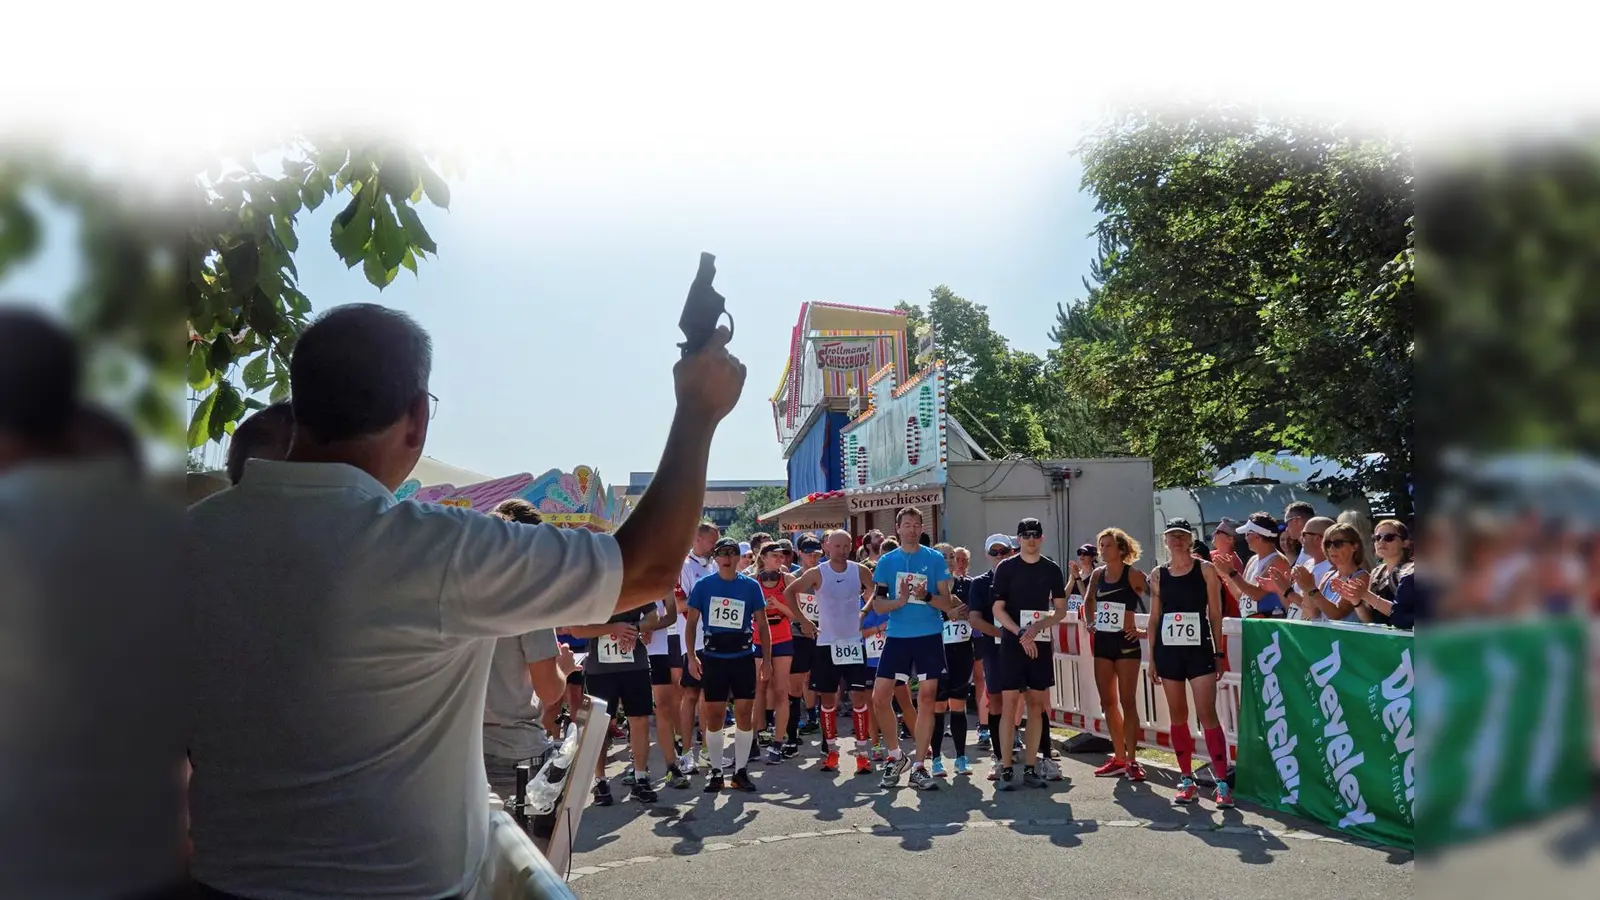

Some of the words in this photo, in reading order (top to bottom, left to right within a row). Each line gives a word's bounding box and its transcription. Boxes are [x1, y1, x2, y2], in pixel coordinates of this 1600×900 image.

[714, 607, 739, 621] 156
[1098, 611, 1119, 625] 233
[945, 624, 967, 636] 173
[1167, 623, 1195, 637] 176
[835, 646, 859, 658] 804
[1257, 630, 1300, 805] Develey
[1310, 640, 1376, 828] Develey
